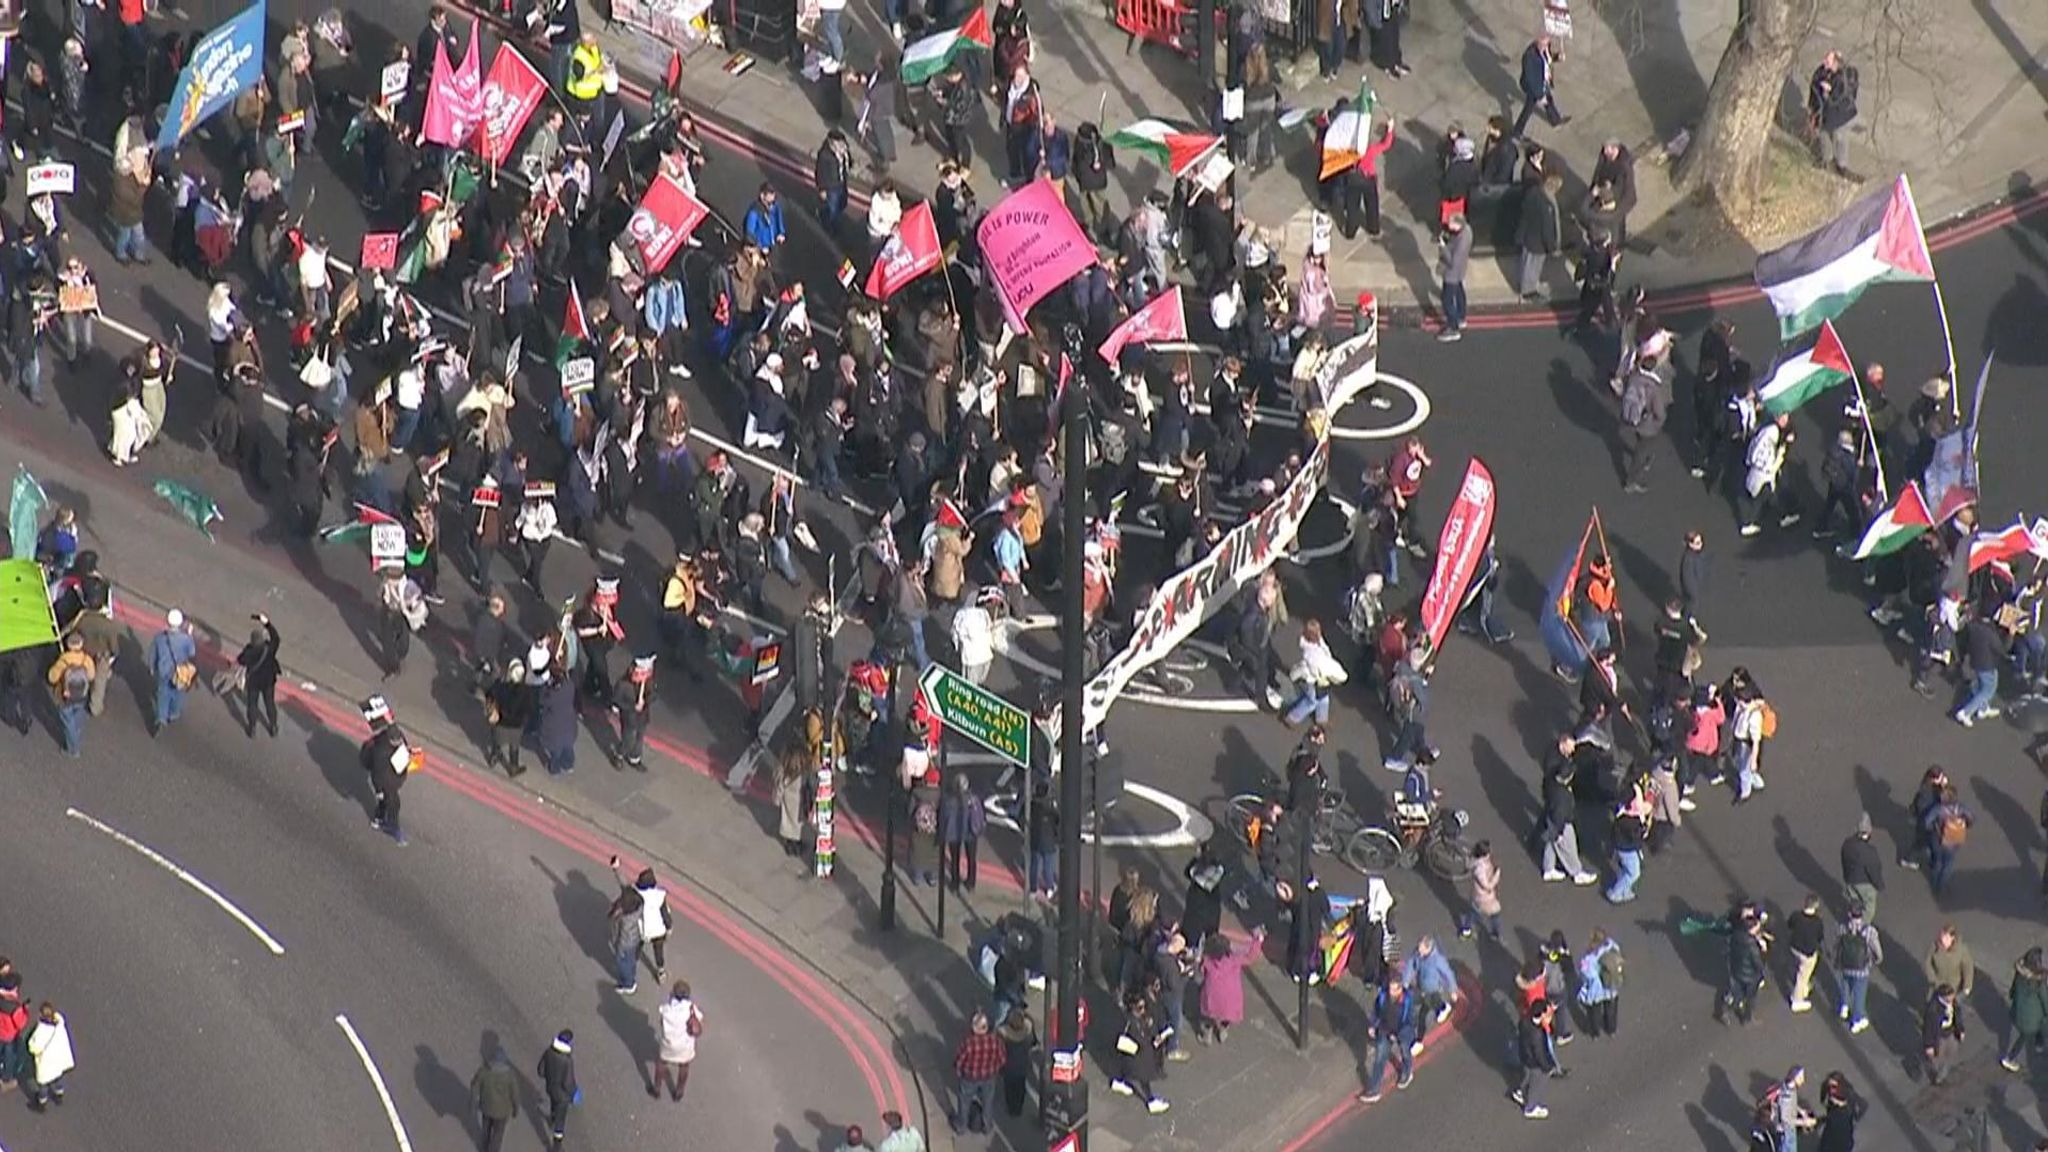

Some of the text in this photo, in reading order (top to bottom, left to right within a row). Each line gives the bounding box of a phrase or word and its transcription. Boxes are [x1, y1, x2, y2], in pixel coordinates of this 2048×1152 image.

[1005, 210, 1050, 227] POWER
[948, 677, 1025, 730] Ring road (N)
[947, 708, 1019, 757] Kilburn (A5)
[984, 713, 1012, 737] A41)
